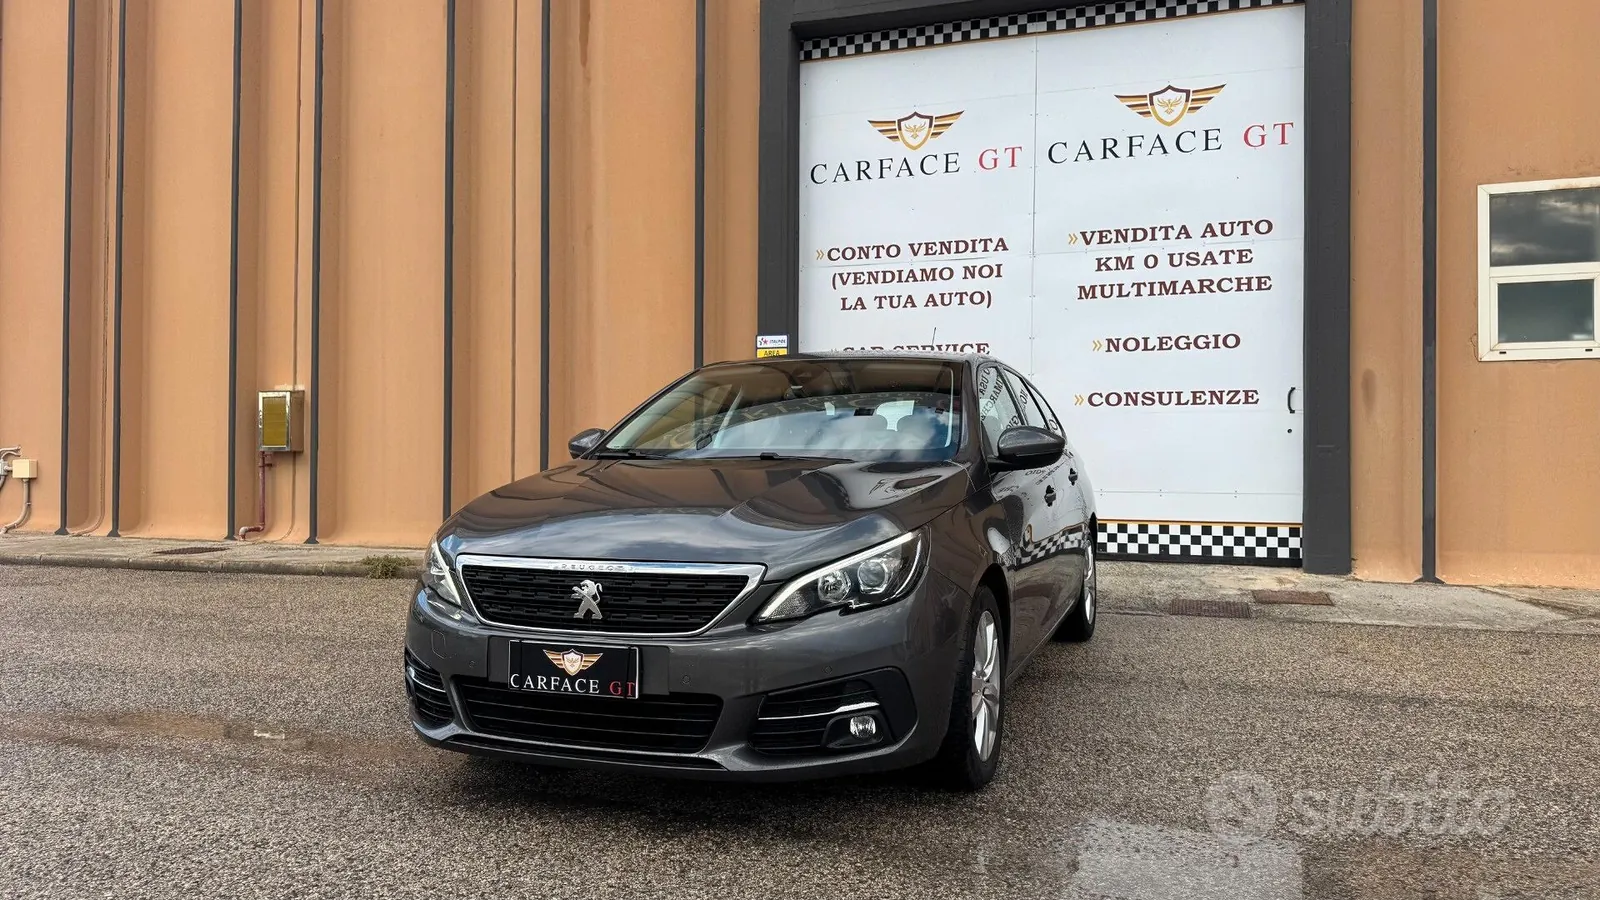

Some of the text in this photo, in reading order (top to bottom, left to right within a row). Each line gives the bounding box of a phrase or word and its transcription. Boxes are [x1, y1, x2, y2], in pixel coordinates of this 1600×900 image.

[1048, 121, 1295, 164] CARFACE GT
[810, 146, 1023, 185] CARFACE GT
[1080, 219, 1274, 246] VENDITA AUTO
[826, 237, 1009, 262] CONTO VENDITA
[1095, 256, 1135, 273] KM
[1167, 248, 1254, 268] USATE
[831, 263, 1003, 291] (VENDIAMO NOI
[1077, 275, 1273, 301] MULTIMARCHE
[840, 290, 992, 311] LA TUA AUTO)
[1105, 333, 1241, 353] NOLEGGIO
[1088, 389, 1260, 408] CONSULENZE
[510, 673, 636, 697] CARFACE GT
